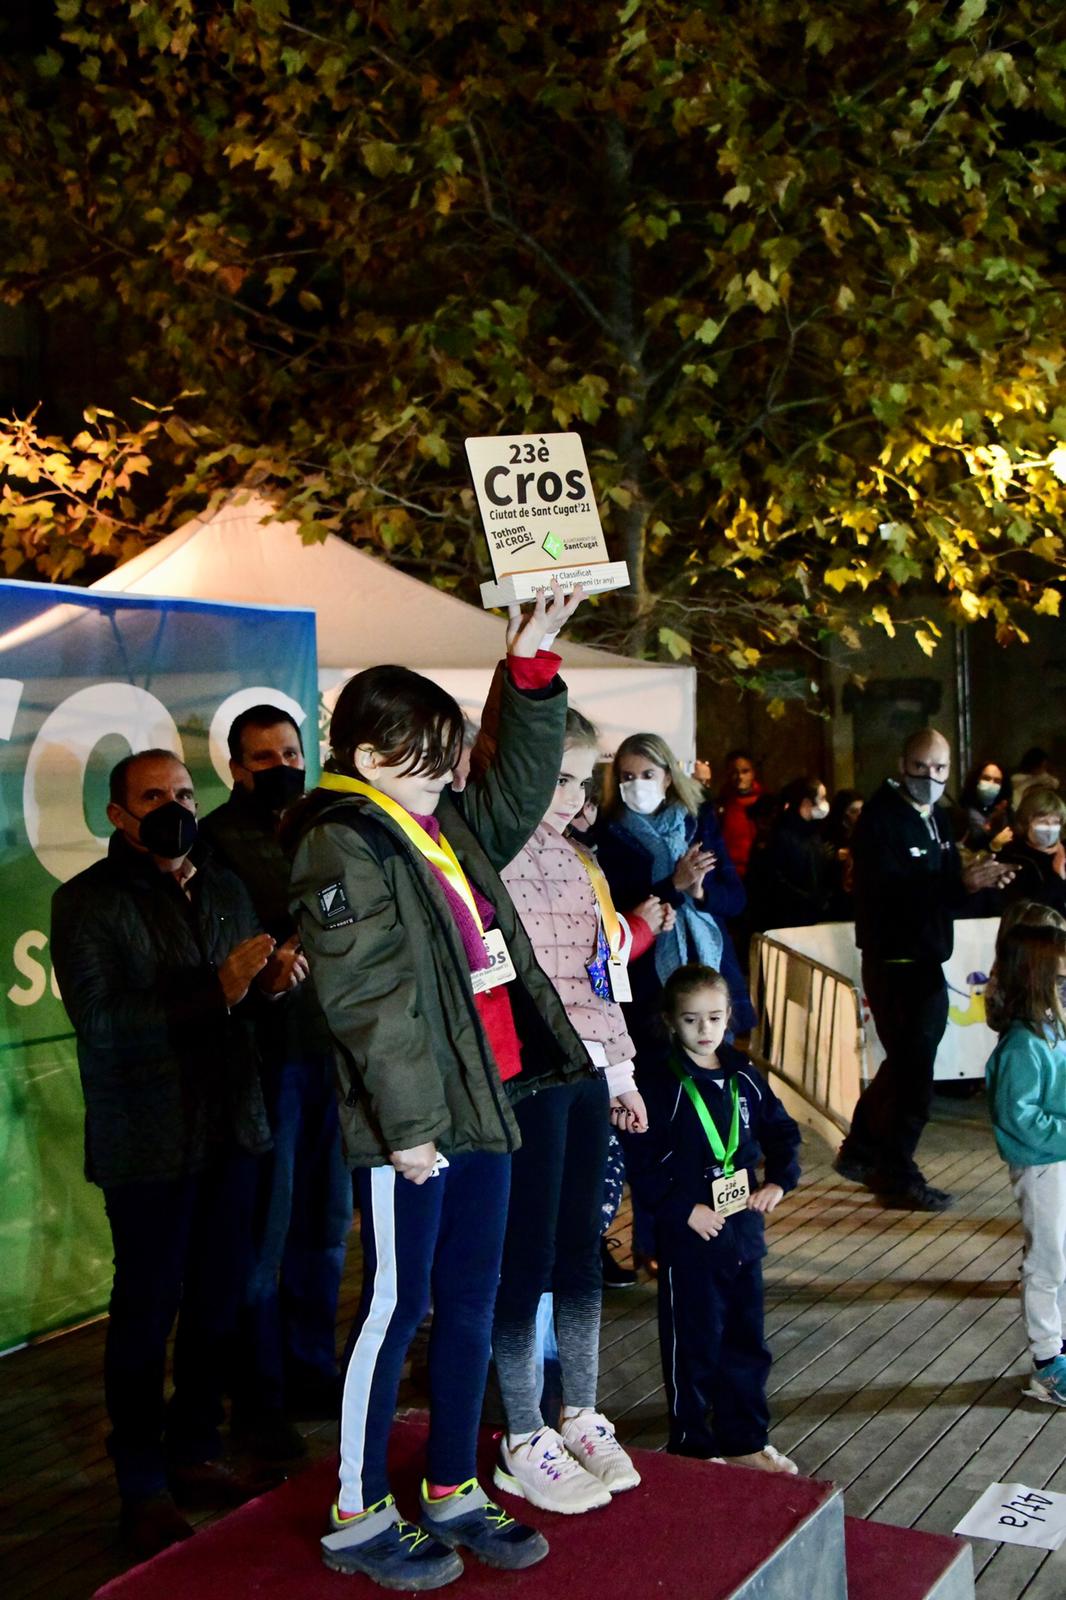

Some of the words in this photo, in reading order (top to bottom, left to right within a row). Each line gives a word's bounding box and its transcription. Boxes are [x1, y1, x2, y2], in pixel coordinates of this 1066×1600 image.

[509, 437, 550, 464] 23è
[484, 465, 586, 506] Cros
[489, 509, 518, 520] Ciutat
[519, 507, 530, 518] de
[531, 506, 552, 517] Sant
[491, 525, 526, 540] Tothom
[495, 542, 505, 550] al
[505, 532, 534, 547] CROS!
[563, 541, 599, 550] SantCugat
[559, 569, 592, 580] Classificat
[717, 1185, 746, 1204] Cros
